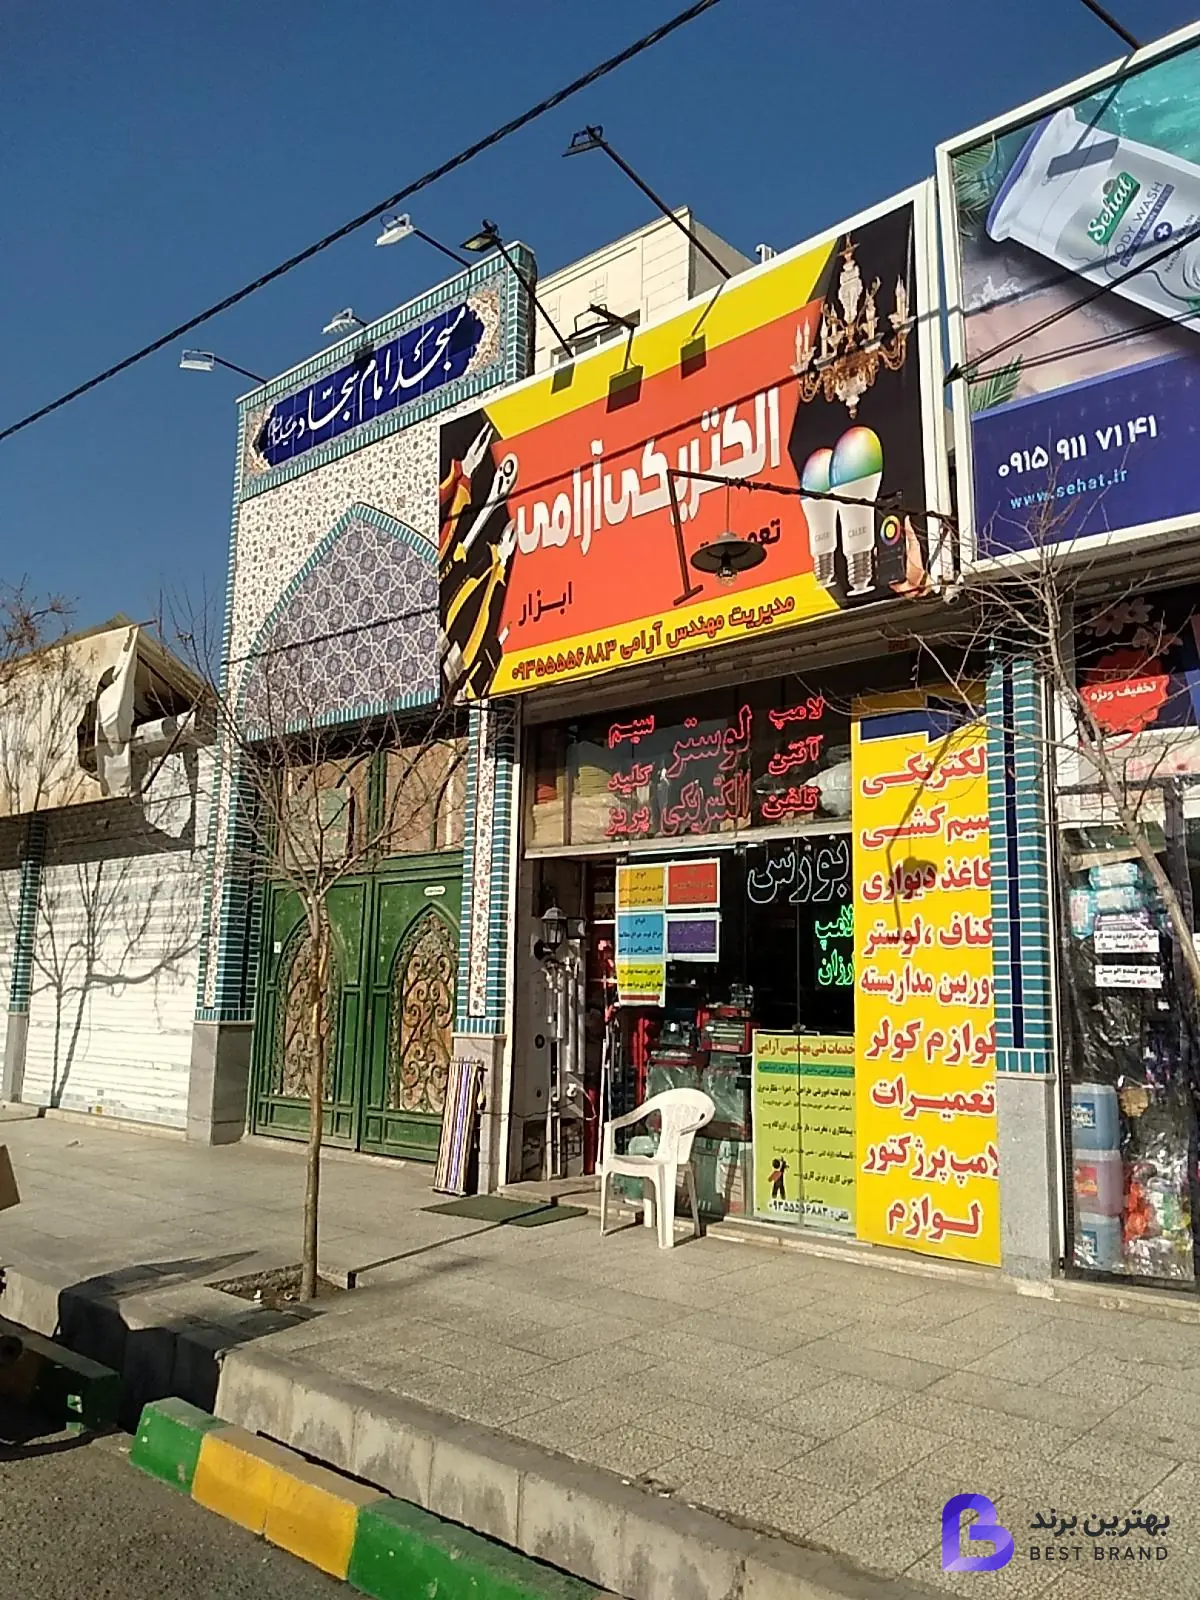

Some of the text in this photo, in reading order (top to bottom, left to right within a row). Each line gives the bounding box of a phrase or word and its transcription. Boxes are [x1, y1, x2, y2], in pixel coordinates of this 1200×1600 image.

[1088, 175, 1131, 240] Sehat
[1133, 181, 1163, 222] WASH
[358, 349, 392, 421] امام
[517, 387, 780, 557] الکتریکی آرامی
[998, 444, 1049, 478] ۰۹۱۵
[1056, 433, 1087, 461] ۹۱۱
[1010, 467, 1128, 510] www.sehat.ir
[518, 581, 573, 627] ابزار
[511, 595, 795, 682] مدیریت مهندس آرامی ۰۹۳۵۵۵۵۶۸۸۳
[768, 695, 825, 730] لامپ
[1090, 681, 1157, 702] تخفیف ویژه
[608, 714, 655, 749] سیم
[666, 704, 753, 779] لوستر
[768, 735, 823, 776] آنتن
[861, 747, 988, 795] لکتریکی
[607, 761, 653, 795] کلید
[660, 769, 751, 836] الکتریکی
[761, 785, 820, 819] تلفن
[861, 806, 946, 848] کشی
[747, 840, 850, 904] بورس
[862, 858, 992, 901] کاغذ دیواری
[939, 913, 994, 945] کناف
[938, 975, 995, 1004] وربین
[866, 1019, 996, 1064] لوازم کولر
[872, 1077, 995, 1119] تعمیرات
[888, 1197, 981, 1240] لوازم
